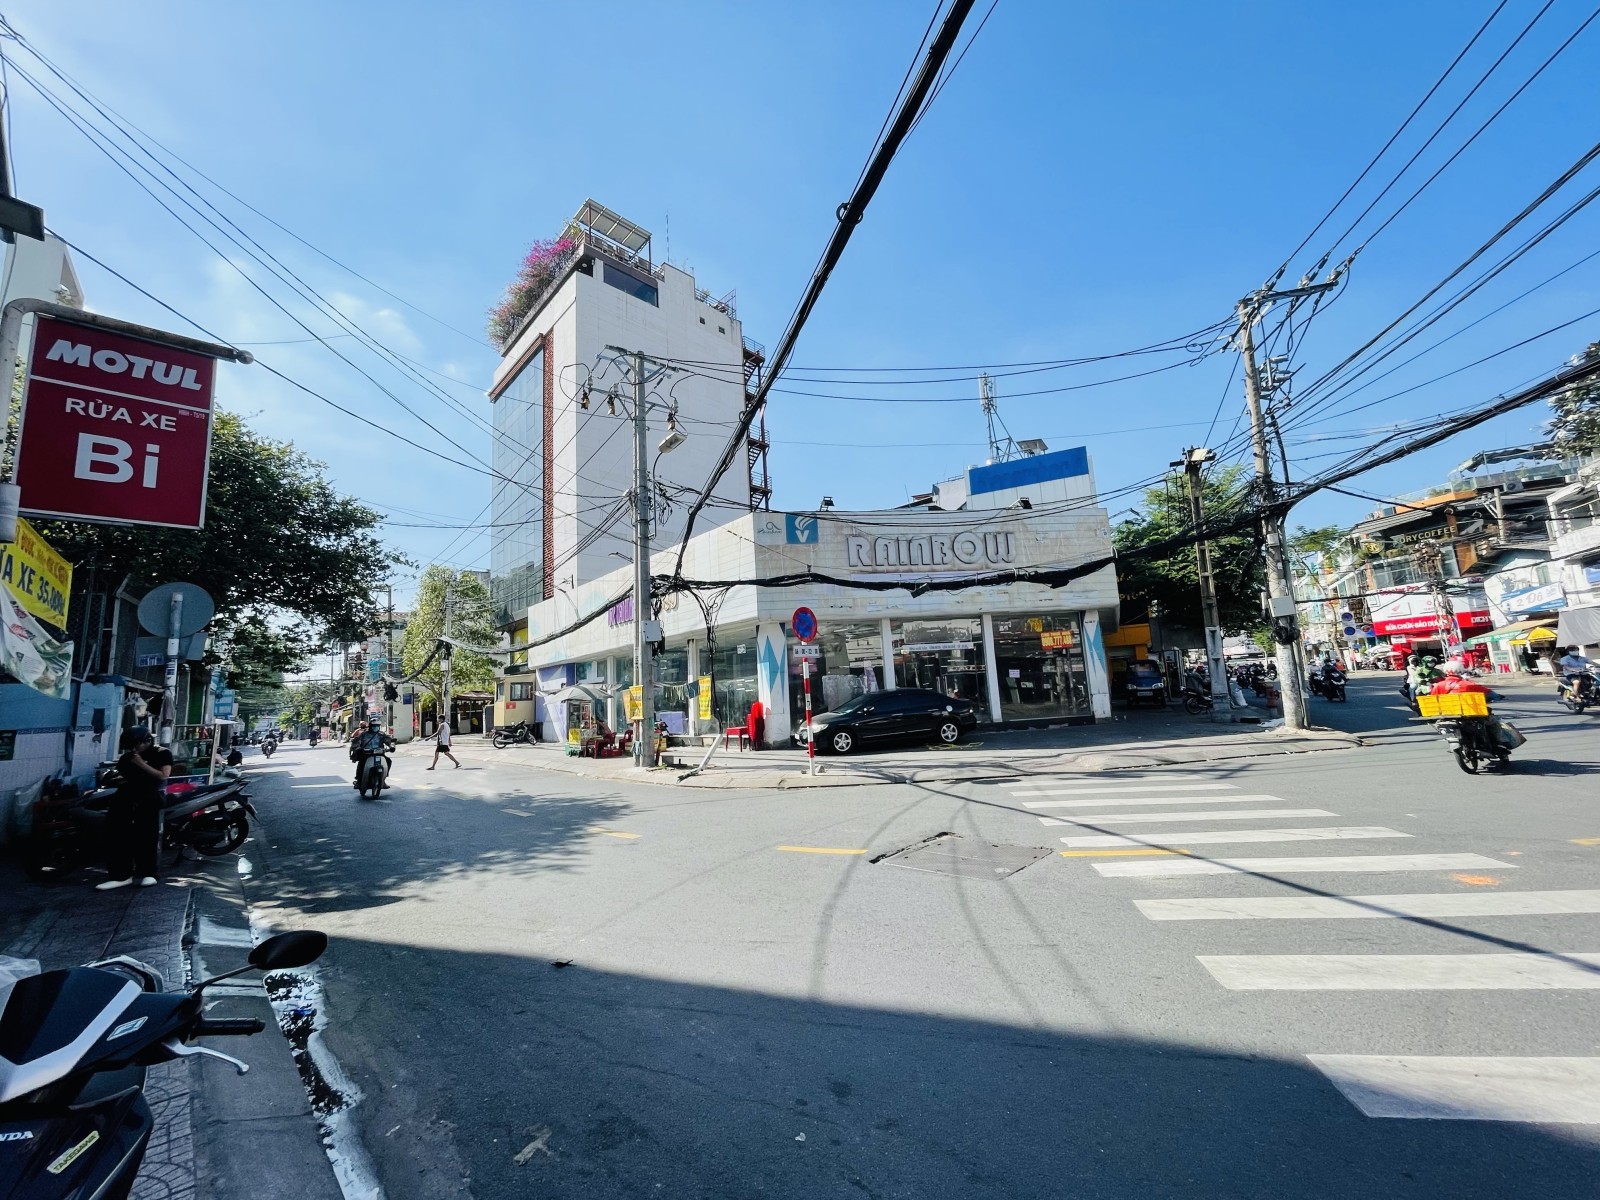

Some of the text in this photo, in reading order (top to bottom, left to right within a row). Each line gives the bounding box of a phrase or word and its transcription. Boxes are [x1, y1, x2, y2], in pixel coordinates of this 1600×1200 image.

[46, 339, 202, 391] MOTUL
[65, 397, 177, 431] RỬA XE
[74, 432, 160, 489] Bi
[847, 531, 1017, 567] RAINBOW
[17, 561, 36, 595] XE
